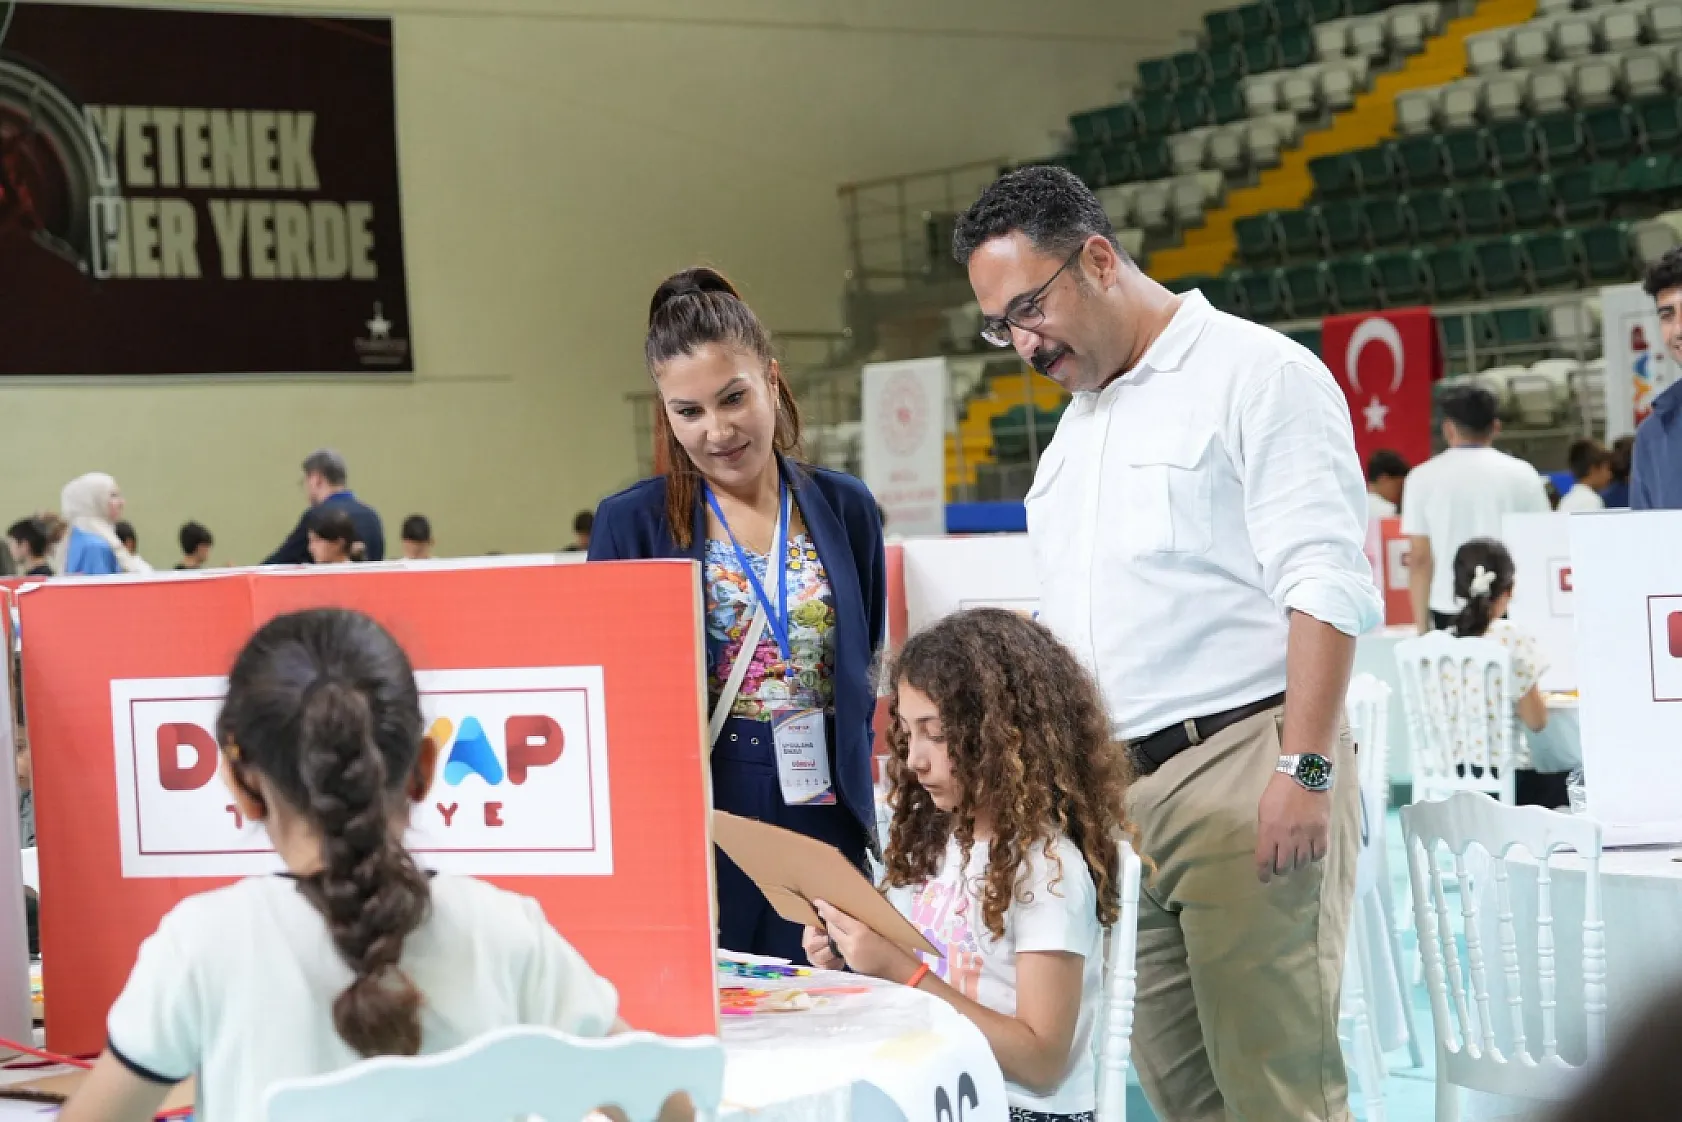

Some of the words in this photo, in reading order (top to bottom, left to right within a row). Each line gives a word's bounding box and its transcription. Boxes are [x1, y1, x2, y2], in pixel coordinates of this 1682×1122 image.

[83, 103, 320, 190] YETENEK
[90, 196, 201, 279] HER
[208, 199, 378, 280] YERDE
